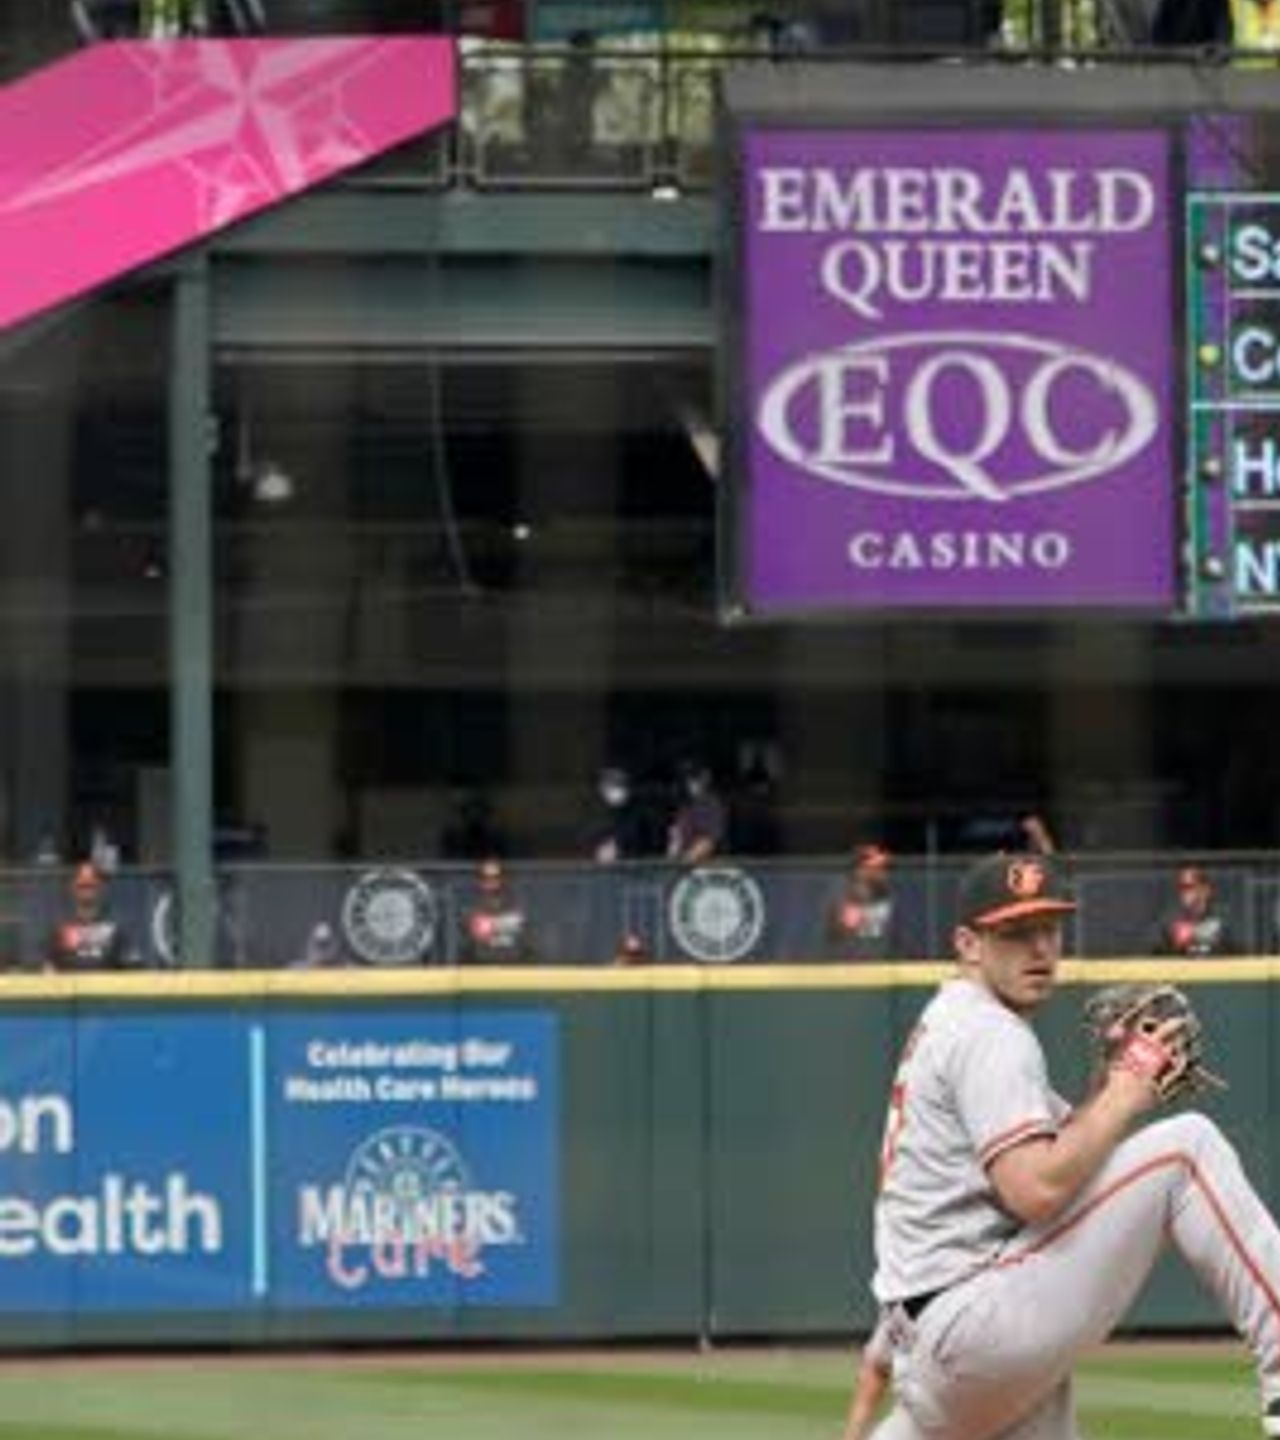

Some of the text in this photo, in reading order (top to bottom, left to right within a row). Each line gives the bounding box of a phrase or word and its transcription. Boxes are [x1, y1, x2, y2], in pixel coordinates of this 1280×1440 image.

[758, 168, 1156, 232] EMERALD
[820, 239, 1094, 319] QUEEN
[812, 350, 1122, 502] EQC
[848, 532, 1072, 568] CASINO
[306, 1042, 457, 1070] Celebrating
[285, 1076, 371, 1101] Health
[375, 1076, 435, 1101] Care
[0, 1172, 221, 1255] ealth
